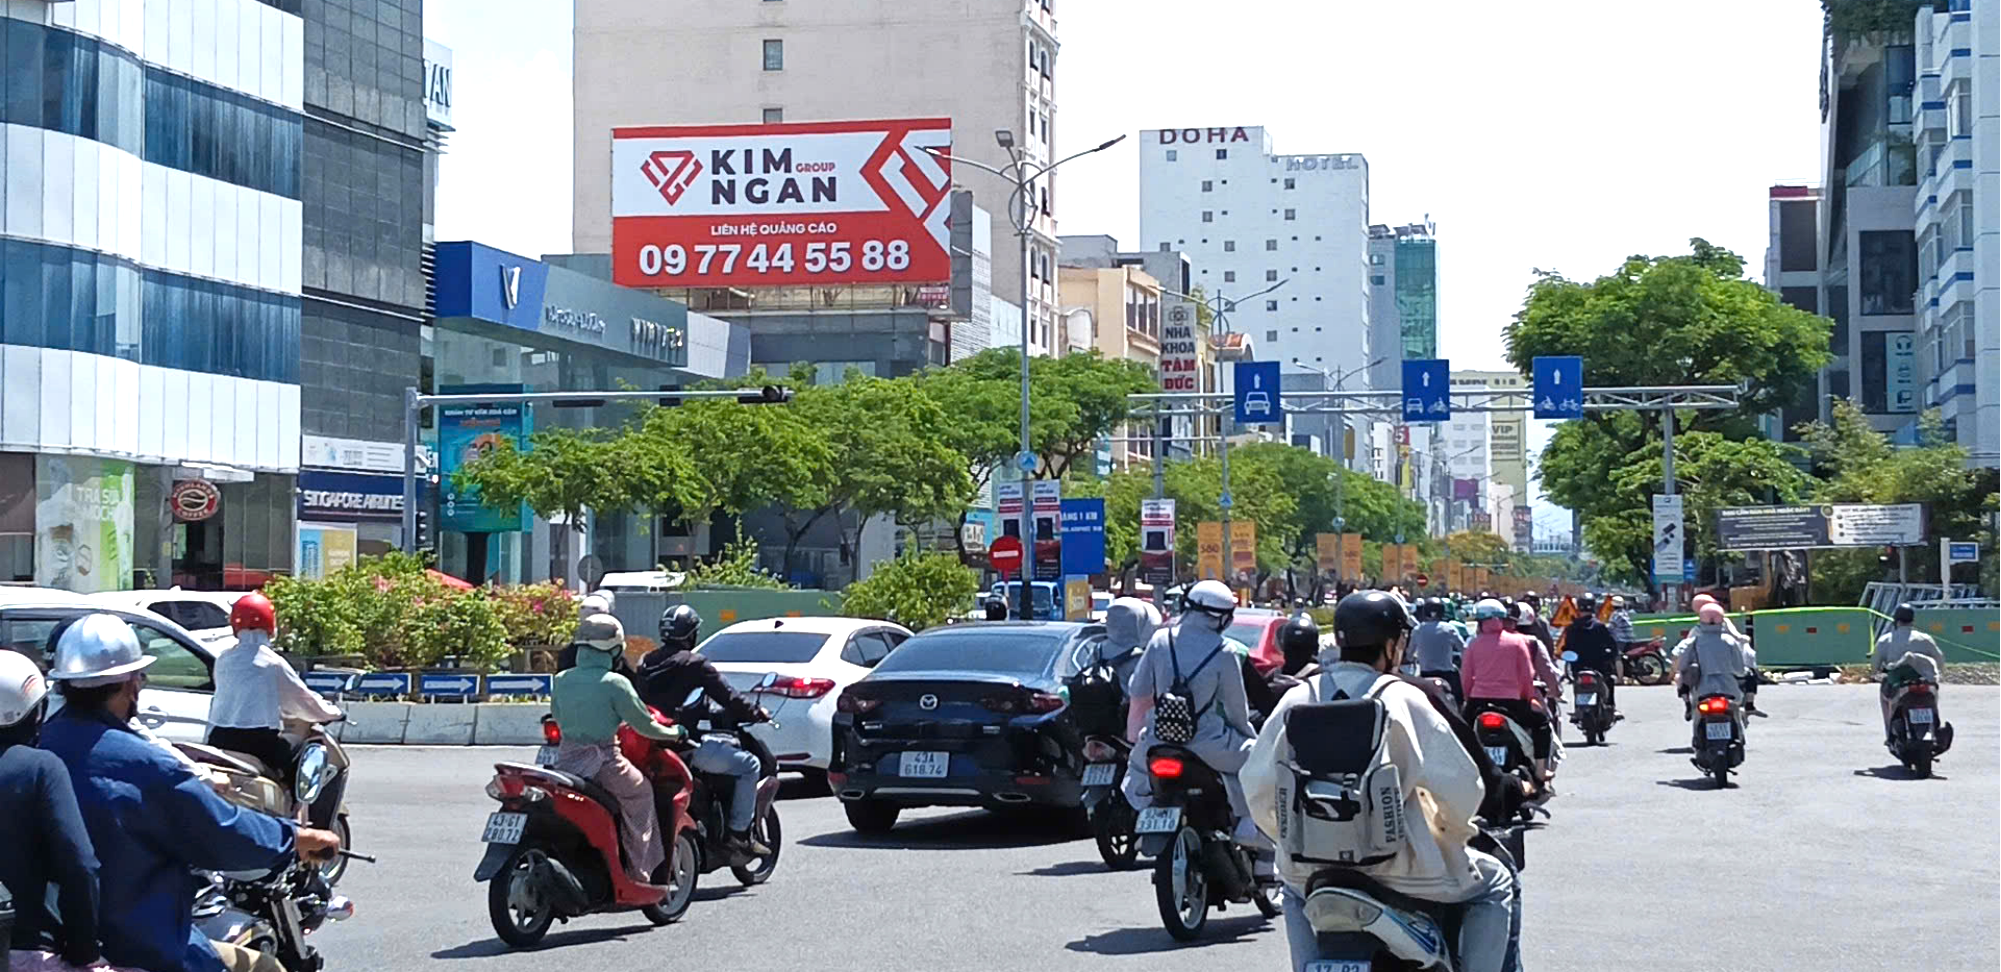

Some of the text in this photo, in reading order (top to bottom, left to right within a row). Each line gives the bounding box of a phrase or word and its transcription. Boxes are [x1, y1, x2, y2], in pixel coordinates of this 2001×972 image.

[1159, 126, 1250, 145] DOHA
[711, 147, 836, 175] KIM GROUP
[1285, 157, 1359, 171] HOTEL
[710, 176, 837, 205] NGAN
[710, 220, 837, 237] LIÊN HỆ QUẢNG CÁO
[638, 239, 910, 275] 09 77 44 55 88
[1161, 342, 1196, 354] KHOA
[1491, 425, 1513, 434] VIP
[303, 490, 363, 509] SINGAPORE
[914, 752, 935, 763] 43A
[1380, 786, 1397, 844] FASHION
